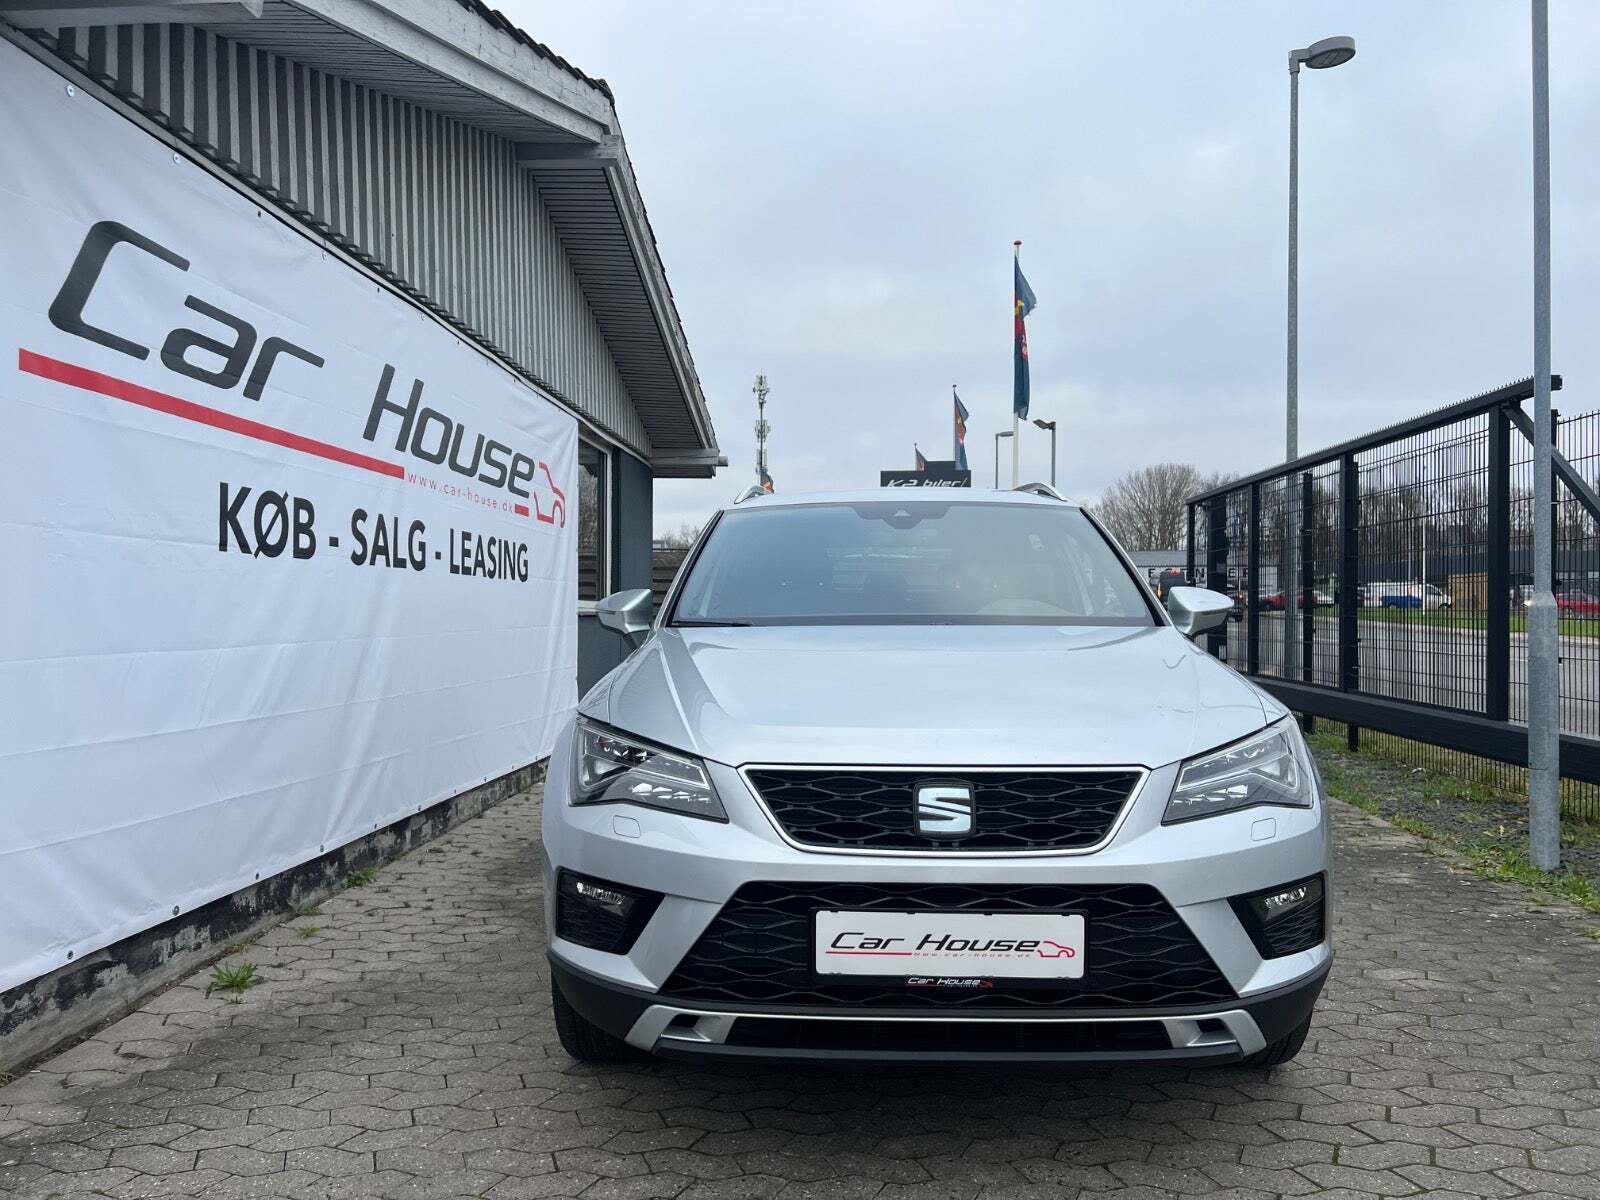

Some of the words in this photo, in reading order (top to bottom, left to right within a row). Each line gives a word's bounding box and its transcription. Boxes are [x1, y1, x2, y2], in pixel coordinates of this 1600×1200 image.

[48, 220, 325, 402] Car
[362, 363, 535, 499] House
[407, 471, 513, 513] www.car-house.dk
[218, 481, 317, 560] KØB
[350, 508, 427, 572] SALG
[449, 528, 529, 583] LEASING
[830, 931, 905, 950] Car
[915, 933, 1041, 952] House
[936, 977, 981, 985] House
